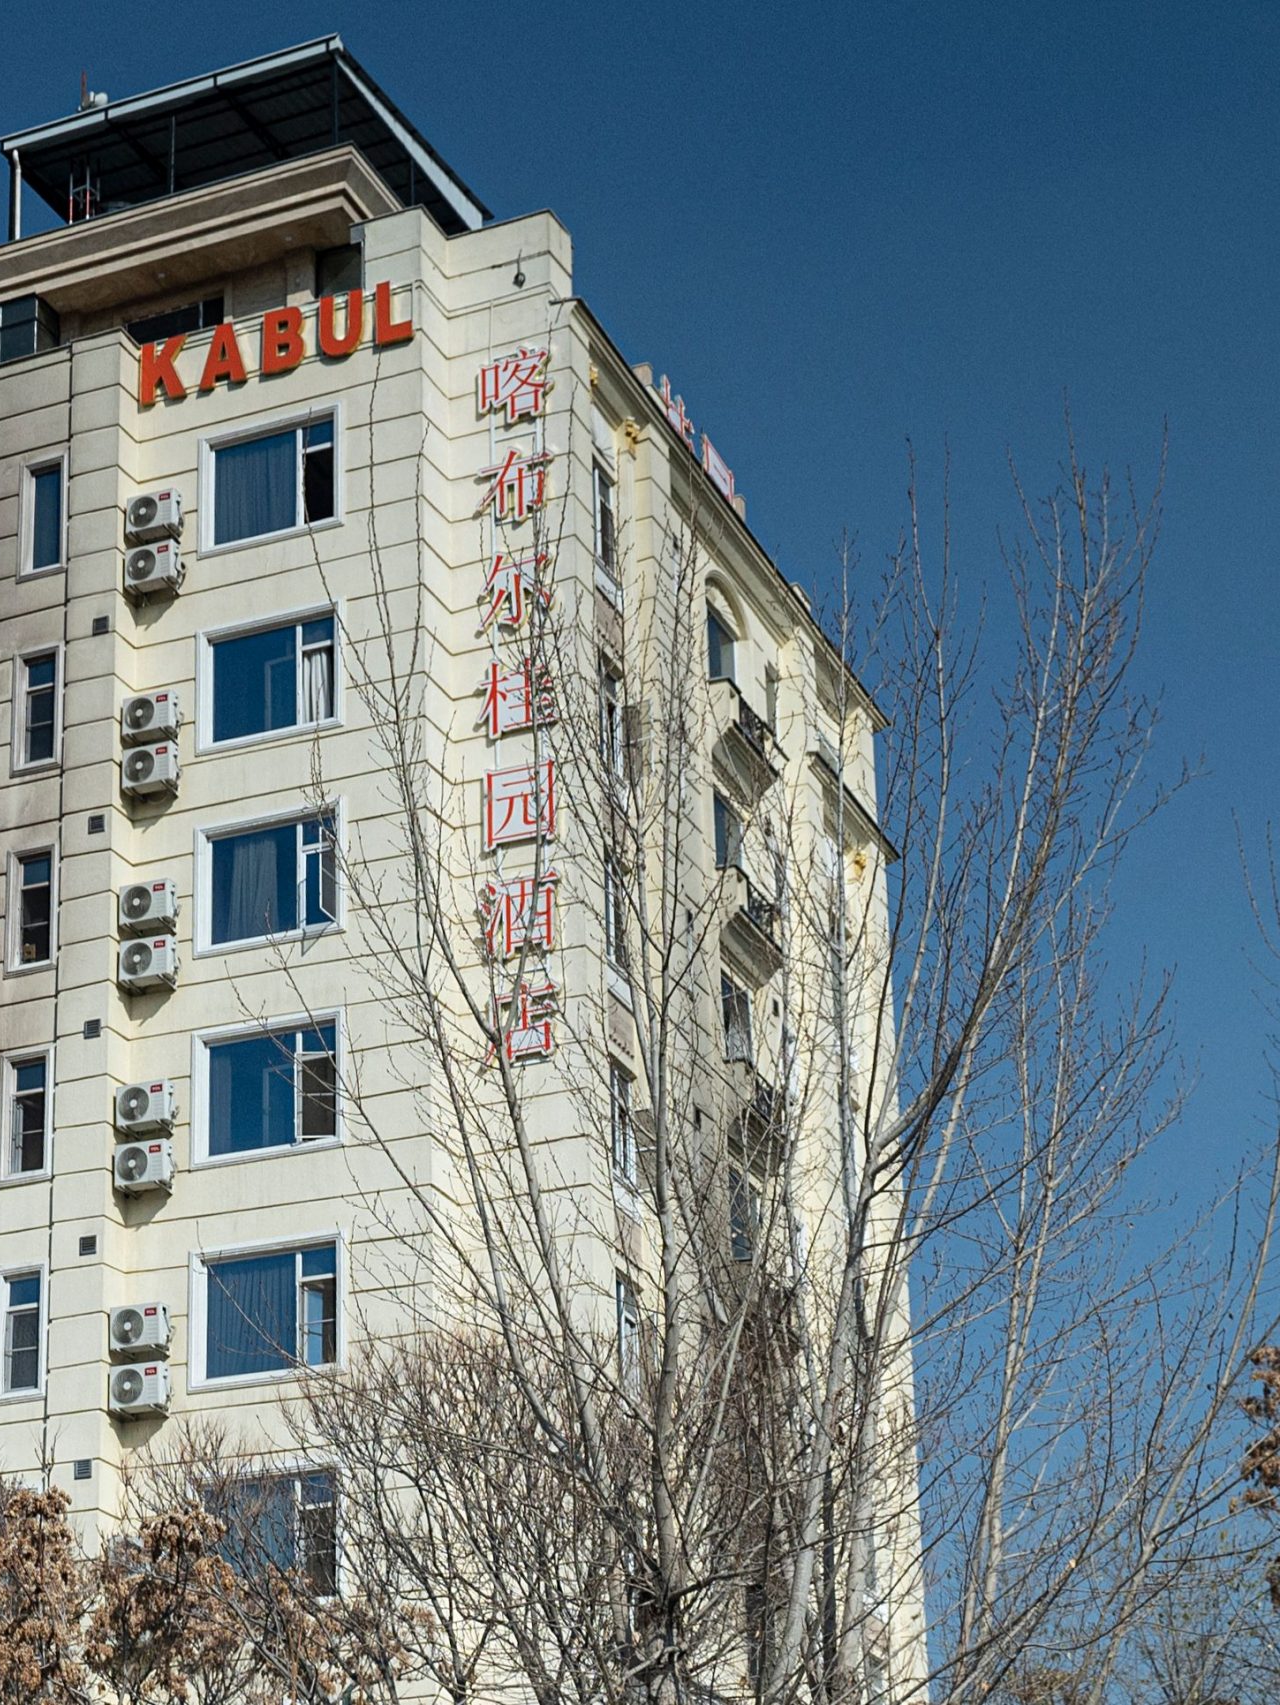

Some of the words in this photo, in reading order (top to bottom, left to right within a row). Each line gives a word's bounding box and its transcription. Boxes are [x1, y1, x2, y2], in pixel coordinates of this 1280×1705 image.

[140, 280, 414, 407] KABUL
[478, 348, 558, 1061] 喀布尔桂园酒店
